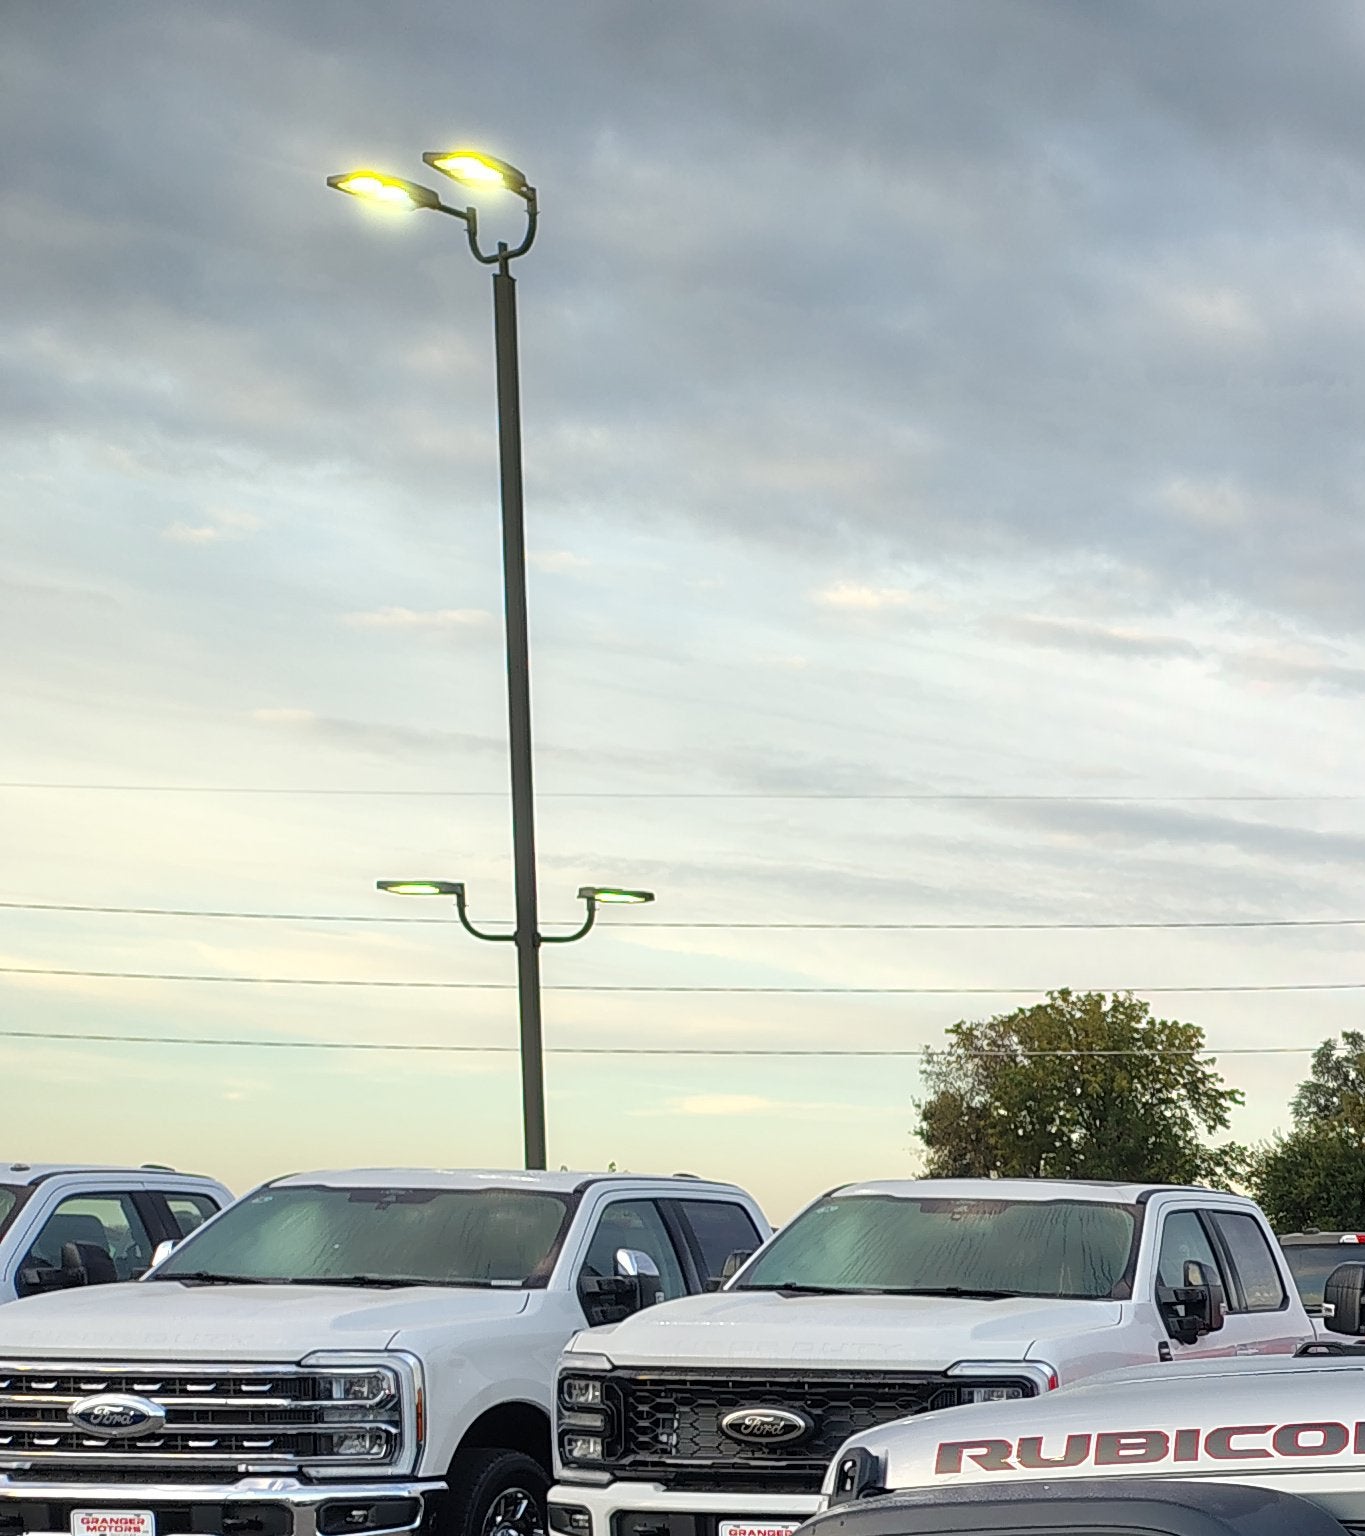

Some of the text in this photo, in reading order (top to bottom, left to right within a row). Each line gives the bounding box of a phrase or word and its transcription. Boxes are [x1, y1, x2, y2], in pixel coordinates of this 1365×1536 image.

[90, 1405, 134, 1425] Ford
[741, 1415, 785, 1435] Ford
[80, 1517, 145, 1525] GRANGER
[86, 1525, 141, 1533] MOTORS
